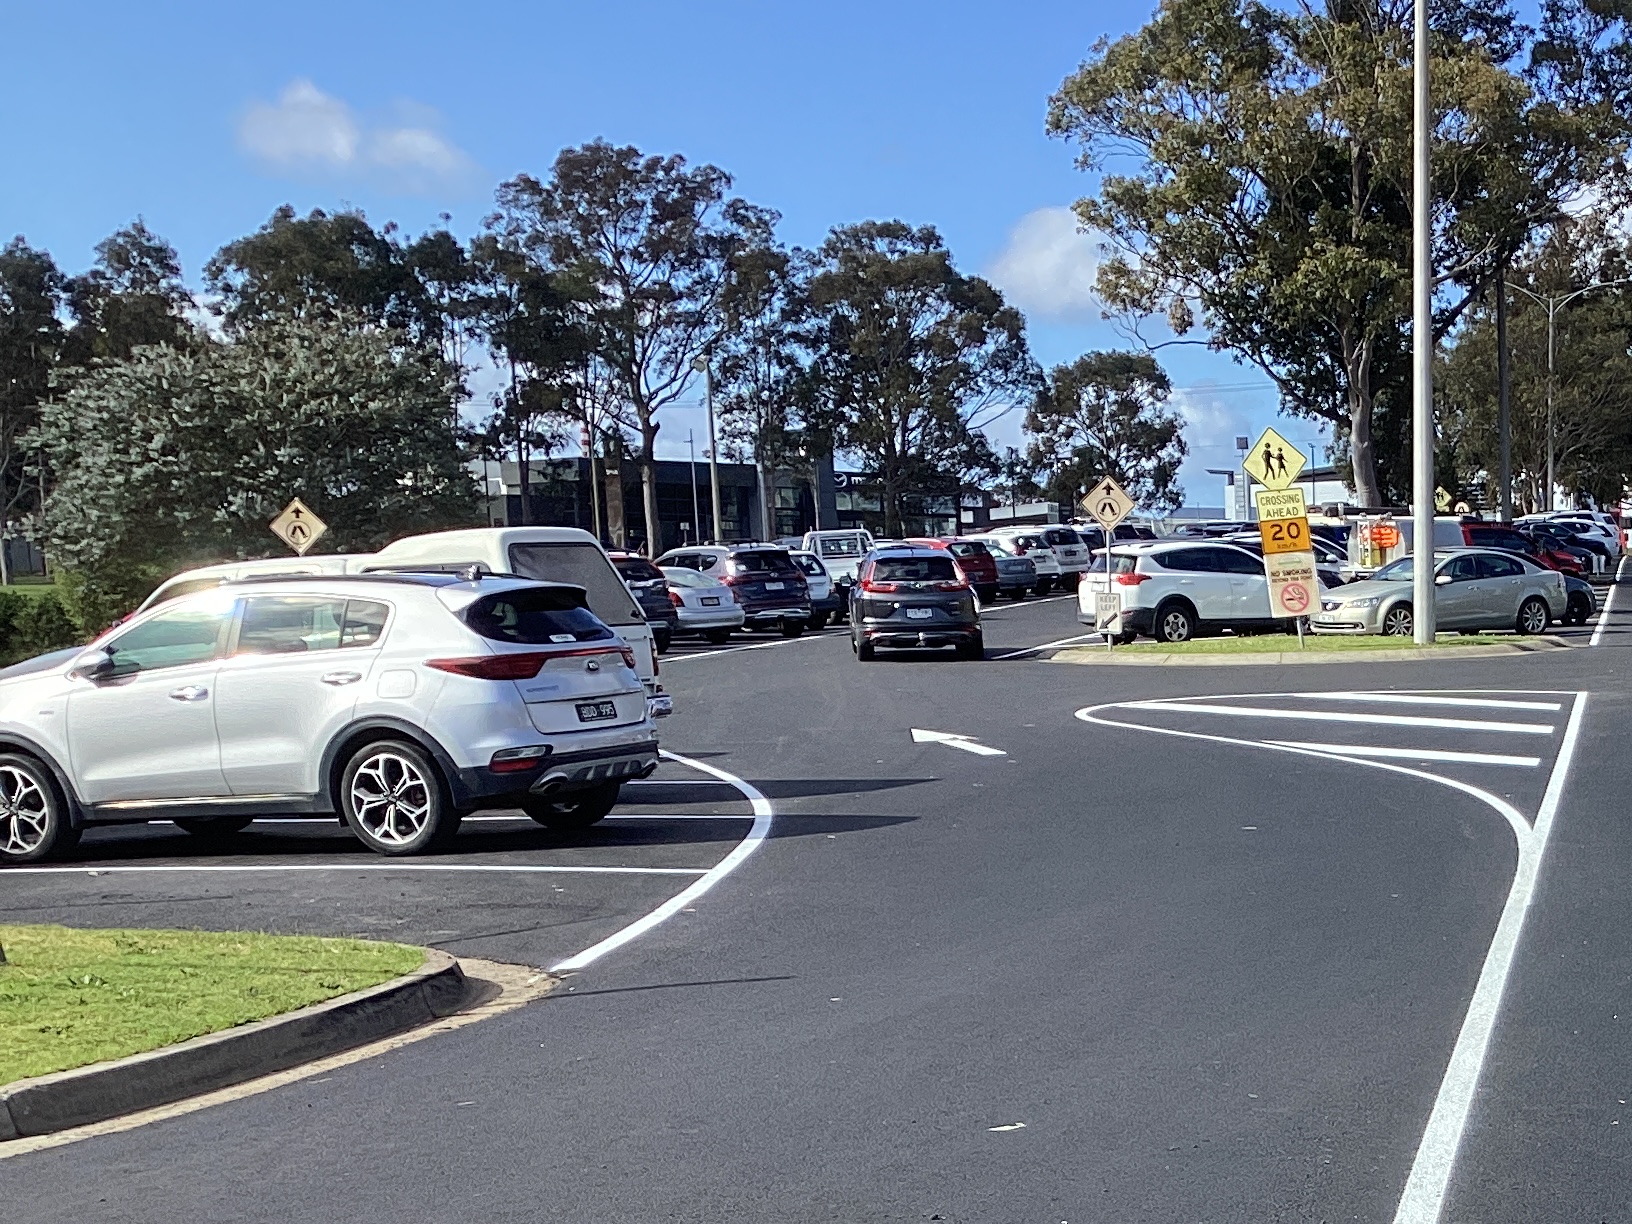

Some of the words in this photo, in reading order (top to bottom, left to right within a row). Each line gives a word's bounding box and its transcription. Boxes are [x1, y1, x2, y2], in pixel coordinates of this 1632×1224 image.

[1260, 494, 1300, 506] CROSSING
[1266, 507, 1299, 518] AHEAD
[1270, 522, 1300, 541] 20
[1282, 568, 1312, 576] SMOKING
